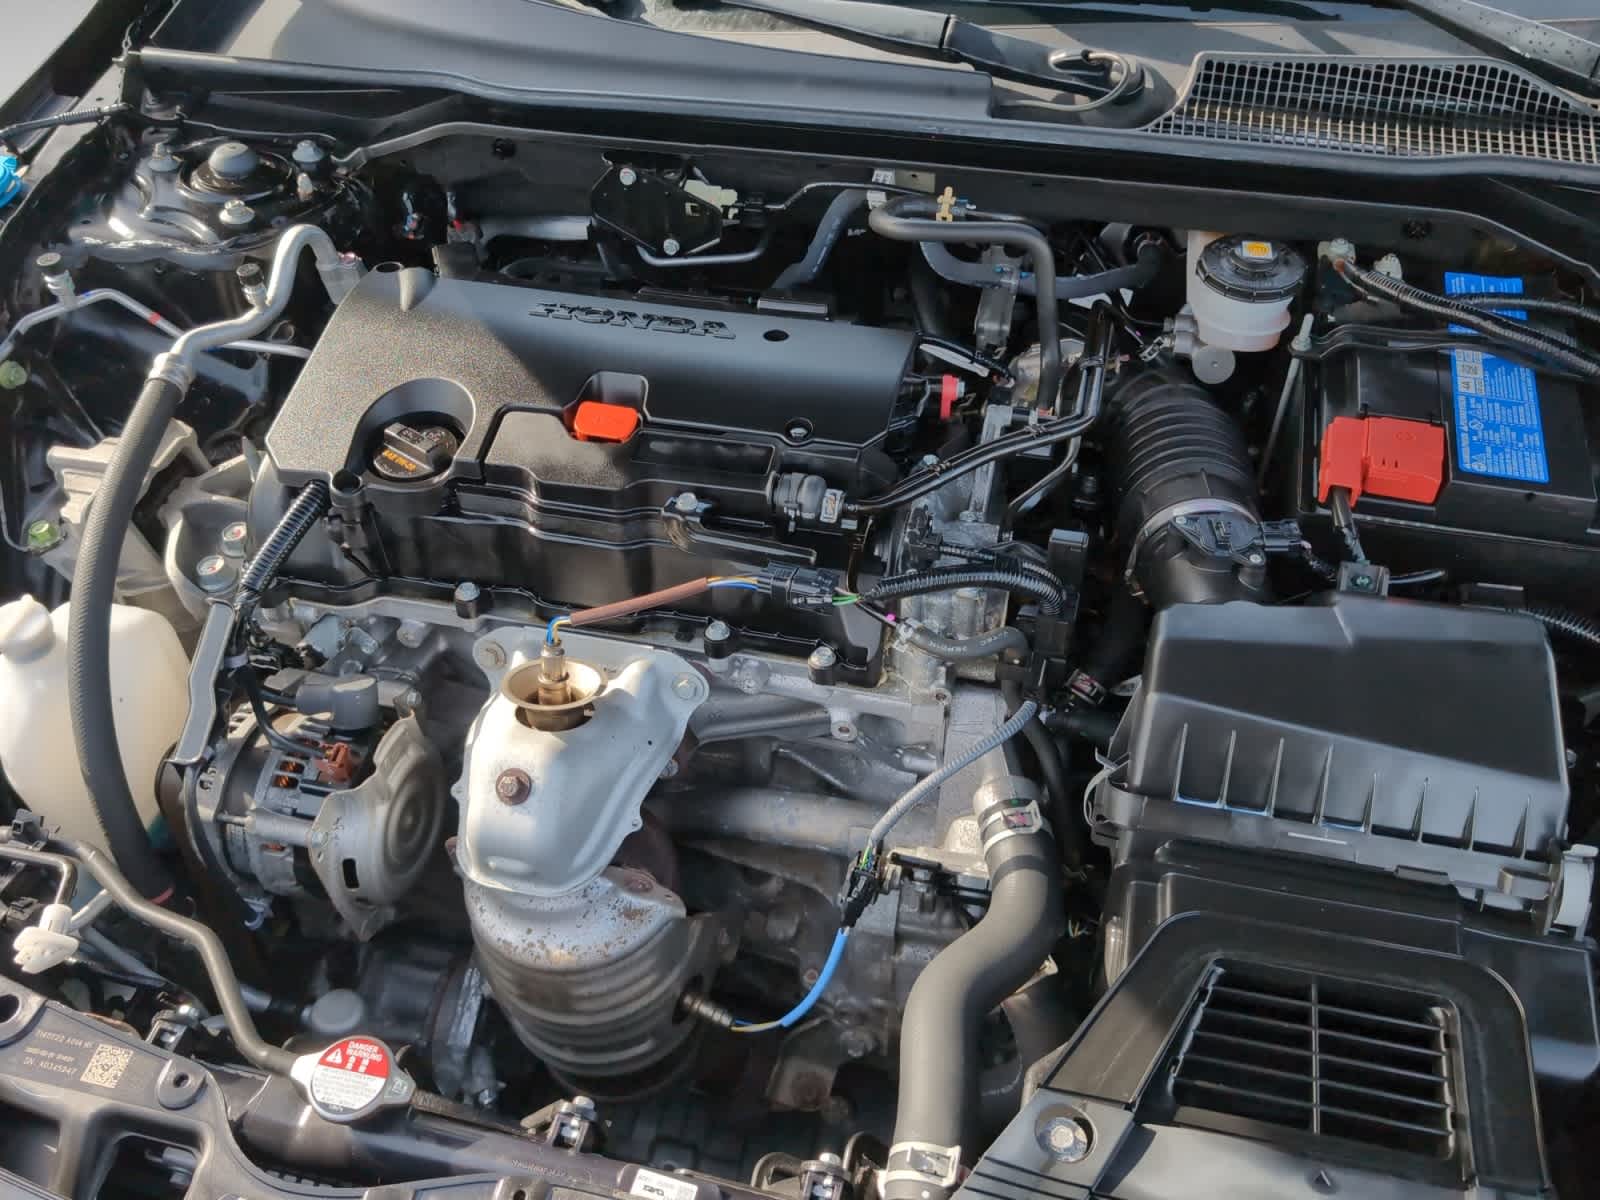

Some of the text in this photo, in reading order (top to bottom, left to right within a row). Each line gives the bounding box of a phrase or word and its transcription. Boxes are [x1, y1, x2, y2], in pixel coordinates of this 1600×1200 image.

[528, 302, 737, 340] HONDA
[348, 1041, 378, 1053] DANGER
[346, 1048, 383, 1062] WARNING
